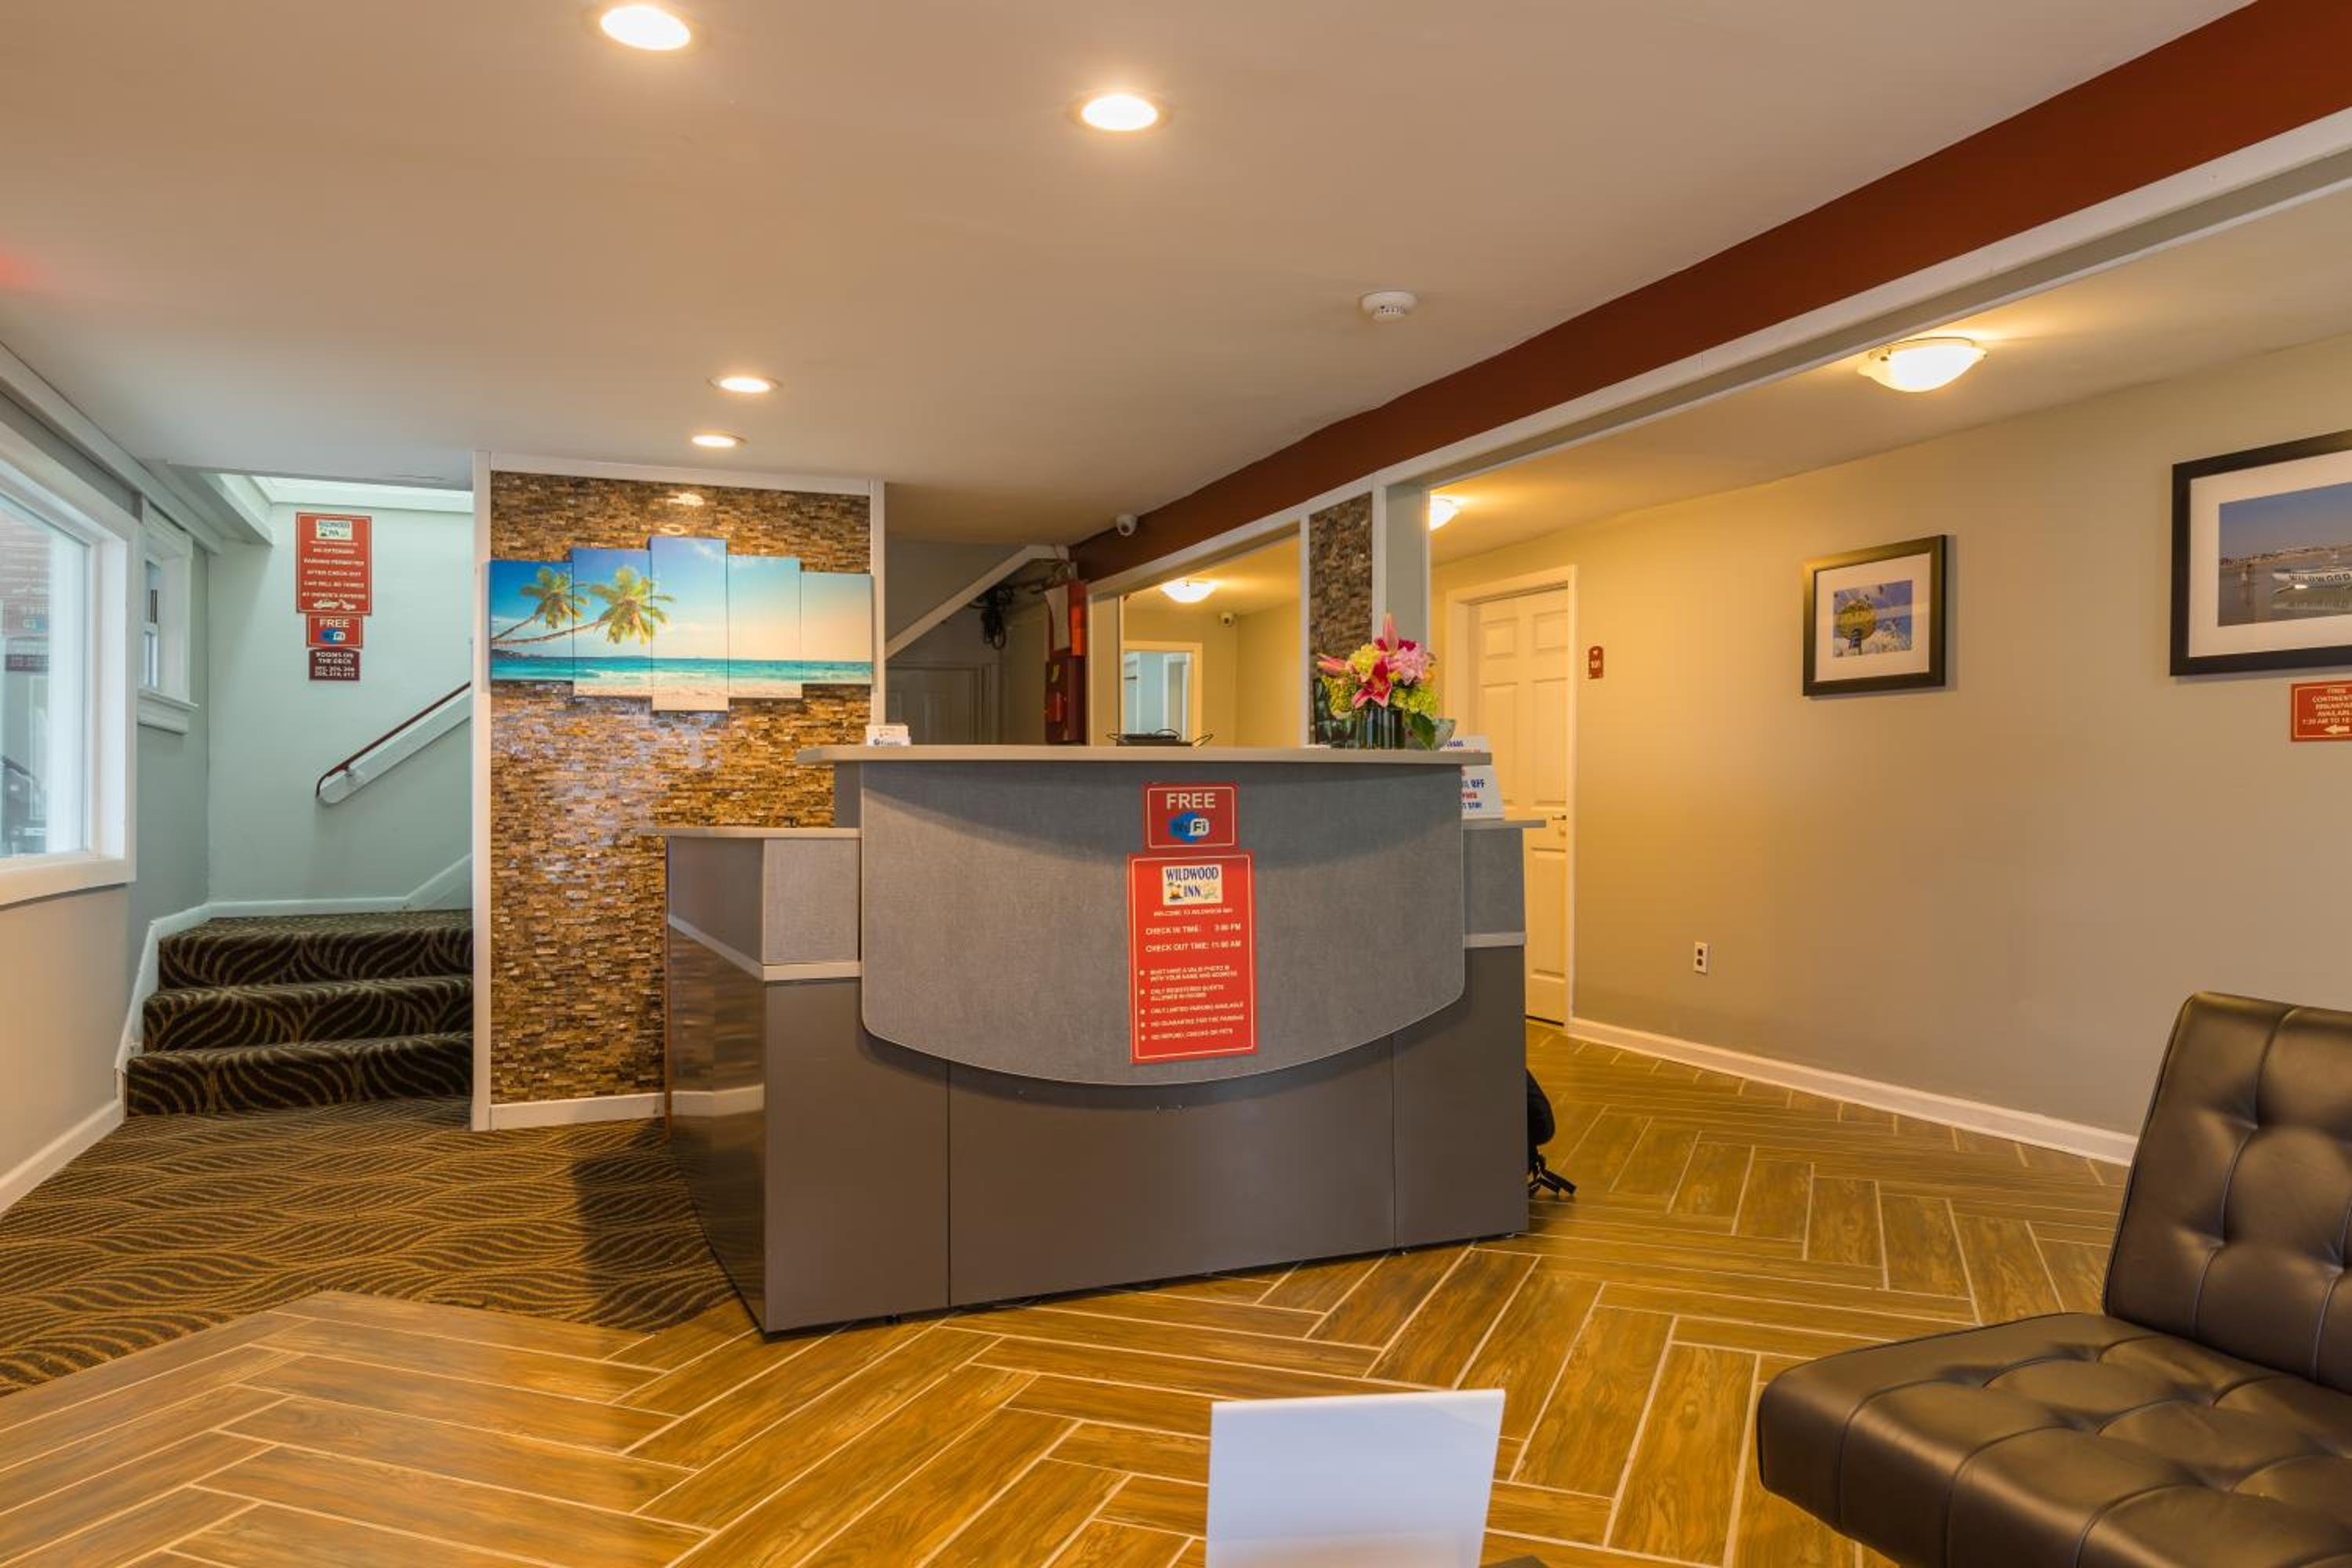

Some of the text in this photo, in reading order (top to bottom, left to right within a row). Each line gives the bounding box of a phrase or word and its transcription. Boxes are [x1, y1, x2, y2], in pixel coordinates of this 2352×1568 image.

[319, 619, 350, 628] FREE
[1166, 793, 1216, 810] FREE
[1166, 867, 1218, 882] WILDWOOD
[1183, 884, 1202, 898] INN
[1145, 927, 1171, 936] CHECK
[1182, 924, 1201, 934] TIME:
[1230, 923, 1241, 931] PM
[1145, 943, 1171, 953] CHECK
[1172, 942, 1189, 951] OUT
[1190, 942, 1209, 950] TIME:
